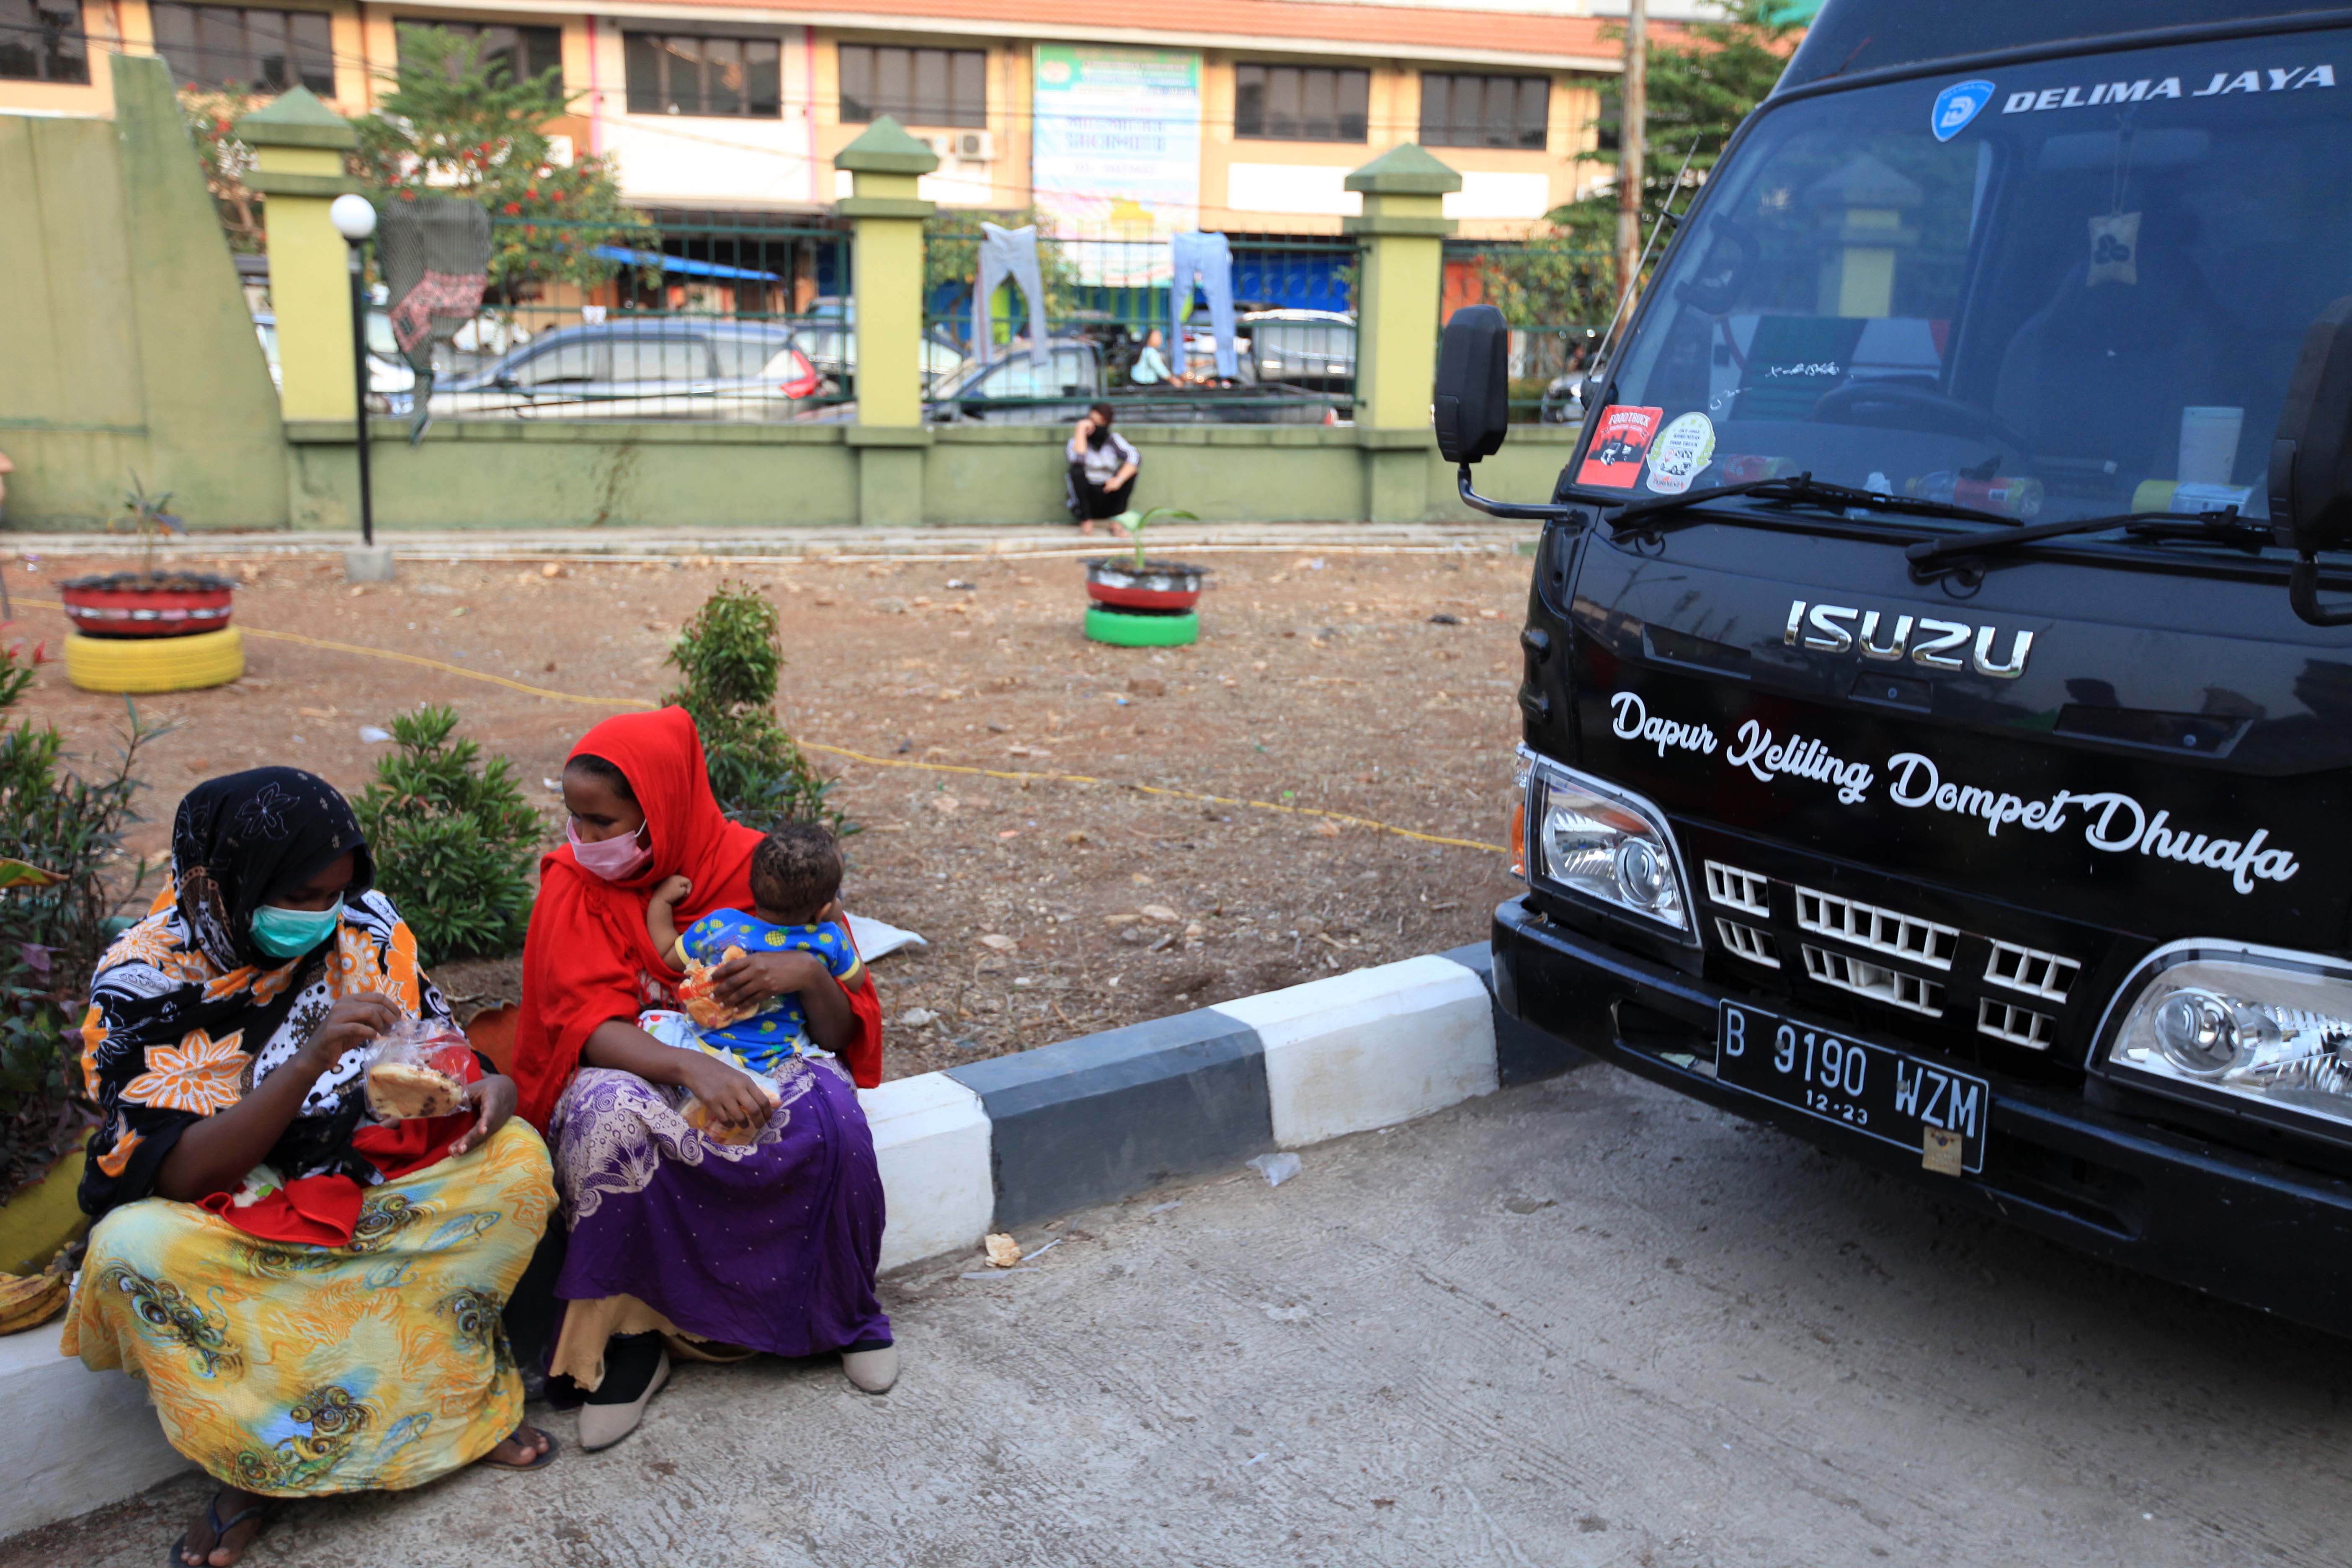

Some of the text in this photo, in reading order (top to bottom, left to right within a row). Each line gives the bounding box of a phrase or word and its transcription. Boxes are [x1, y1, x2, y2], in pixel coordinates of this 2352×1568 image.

[2001, 77, 2181, 114] DELIMA
[2192, 65, 2337, 97] JAYA
[1608, 412, 1651, 428] FOOD TRUCK
[1784, 600, 2034, 679] ISUZU
[1611, 691, 2299, 895] Dapur Keliling Dompet Dhuafa
[1726, 1008, 1979, 1138] B 9190 WZM
